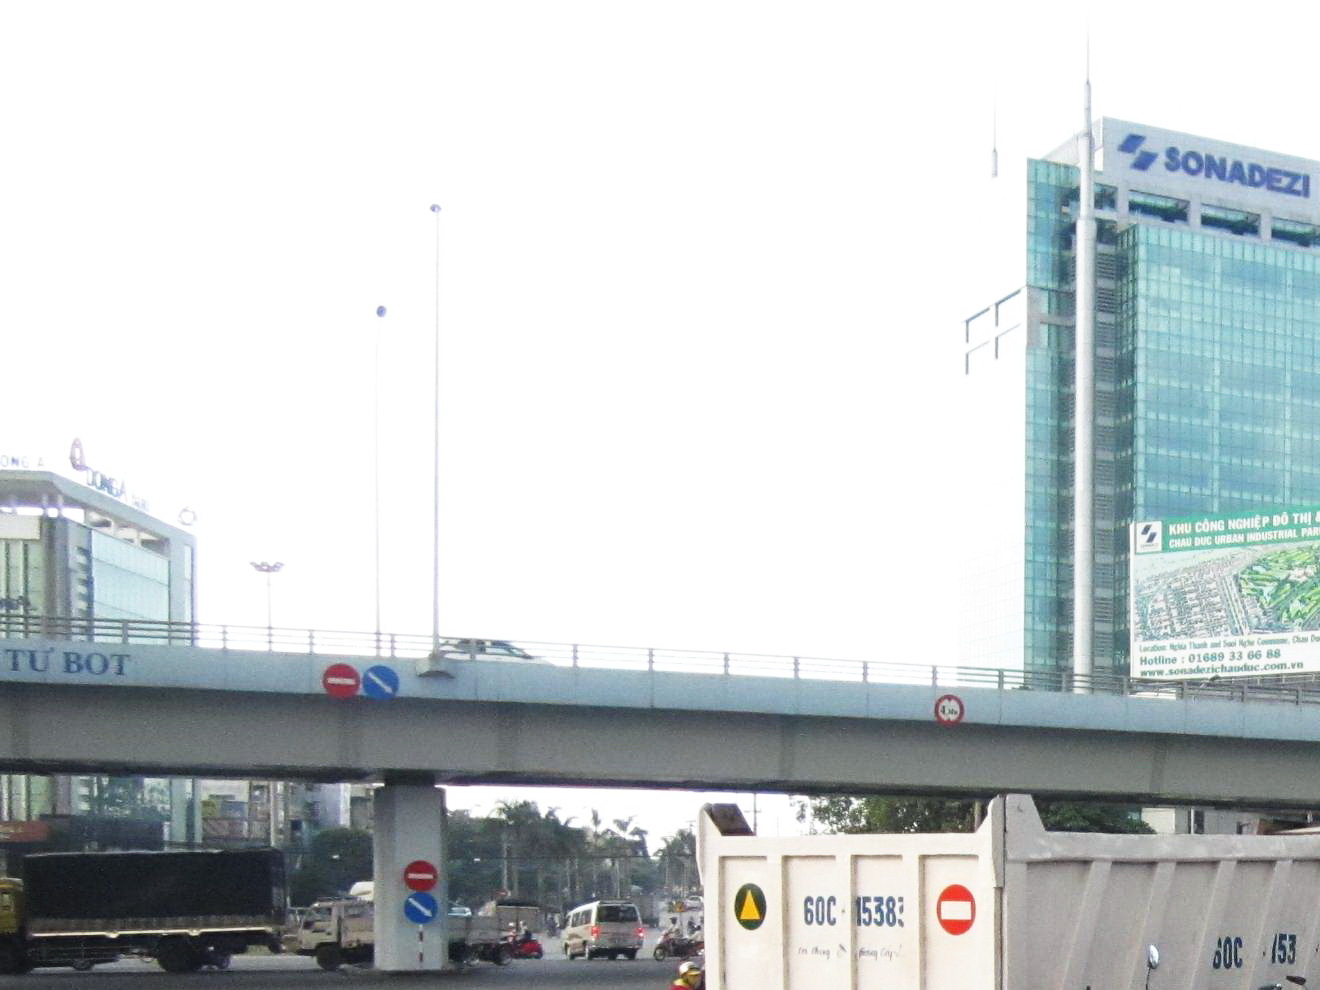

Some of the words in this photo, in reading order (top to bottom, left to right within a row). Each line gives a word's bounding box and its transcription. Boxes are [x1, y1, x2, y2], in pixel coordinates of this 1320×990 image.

[1165, 147, 1310, 198] SONADEZI
[1168, 523, 1191, 536] KHU
[1195, 518, 1225, 533] CÔNG
[1228, 514, 1269, 531] NGHIỆP
[1273, 512, 1289, 527] ĐÔ
[1292, 511, 1312, 526] THỊ
[1168, 537, 1192, 549] CHAU
[1194, 536, 1212, 547] DUC
[1215, 533, 1244, 545] URBAN
[1247, 529, 1297, 543] INDUSTRIAL
[5, 647, 54, 672] TƯ
[63, 651, 131, 676] BOT
[1140, 655, 1177, 666] Hotline
[1229, 651, 1243, 661] 33
[1266, 648, 1281, 659] 88
[803, 895, 837, 926] 60C
